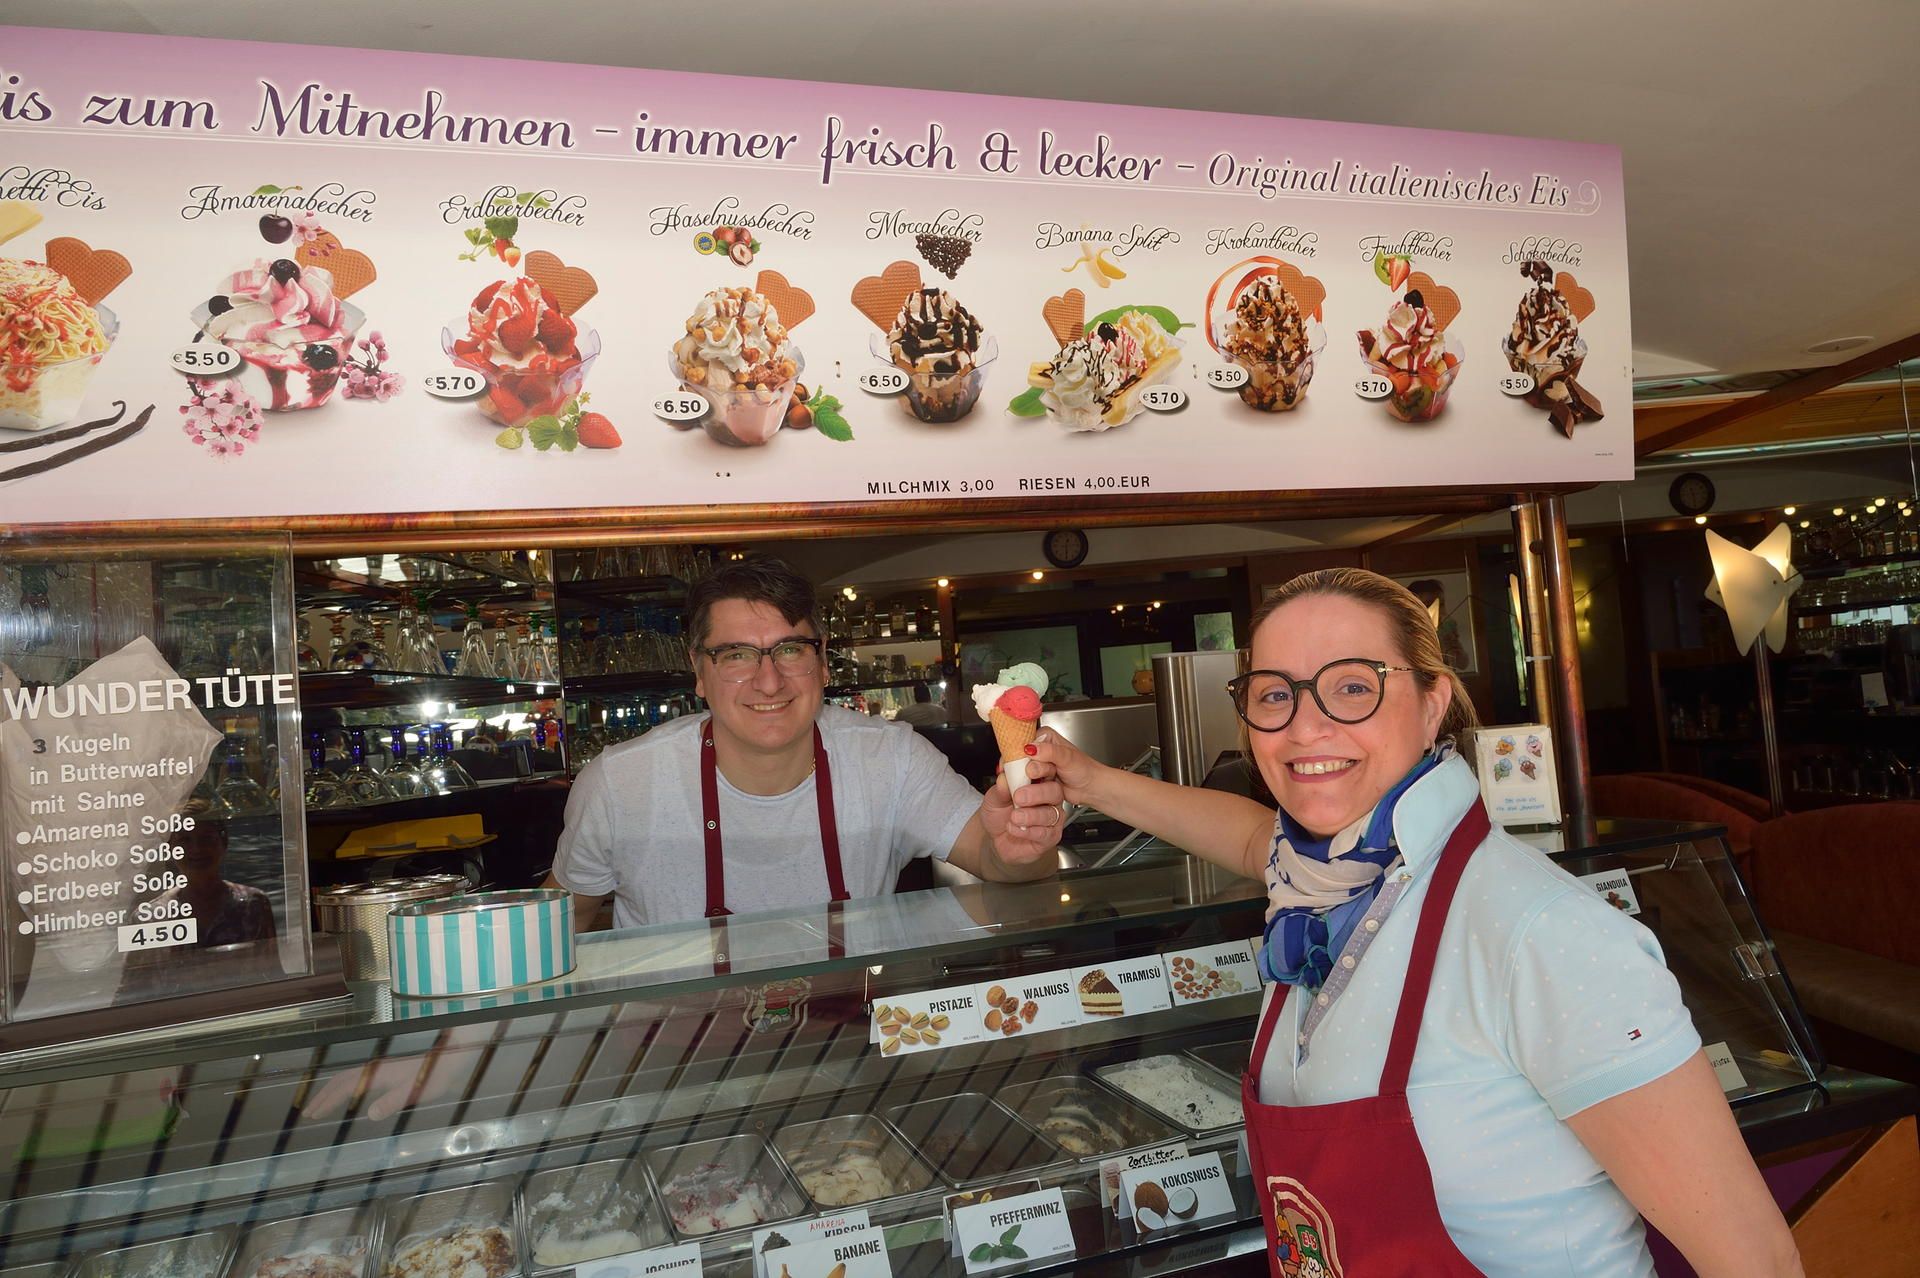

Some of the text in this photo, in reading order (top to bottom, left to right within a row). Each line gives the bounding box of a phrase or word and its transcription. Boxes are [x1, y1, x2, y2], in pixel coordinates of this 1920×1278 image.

[0, 75, 52, 122] is
[82, 95, 219, 129] zum
[251, 80, 575, 148] Mitnehmen
[634, 112, 797, 160] immer
[820, 116, 956, 184] frisch
[979, 131, 1018, 173] &
[1039, 131, 1161, 181] lecker
[1208, 152, 1341, 199] Original
[1349, 164, 1521, 204] italienisches
[1527, 174, 1570, 207] Eis
[57, 180, 106, 210] Eis
[181, 183, 376, 223] Amarenabecher
[438, 185, 587, 227] Erdbeerbecher
[649, 196, 815, 240] Haselnussbecher
[865, 208, 984, 243] Moccabecher
[1035, 222, 1181, 257] Banana Split
[1205, 221, 1319, 258] Krokantbecher
[1359, 229, 1454, 263] Fruchtbecher
[1501, 236, 1583, 267] Schokobecher
[866, 479, 995, 494] MILCHMIX 3,00
[1018, 476, 1077, 491] RIESEN
[32, 732, 131, 757] 3 Kugeln
[29, 756, 194, 786] in Butterwaffel
[30, 790, 145, 815] mit Sahne
[31, 813, 196, 844] Amarena Soße
[32, 842, 185, 874] Schoko Soße
[33, 870, 188, 904] Erdbeer Soße
[1595, 878, 1629, 893] GIANDUIA
[34, 899, 193, 934] Himbeer Soße
[131, 923, 188, 946] 4.50
[1214, 951, 1251, 967] MANDEL
[929, 996, 974, 1014] PISTAZIE
[1022, 982, 1070, 1000] WALNUSS
[1160, 1166, 1220, 1189] KOKOSNUSS
[990, 1201, 1061, 1228] PFEFFERMINZ
[833, 1239, 881, 1262] BANANE
